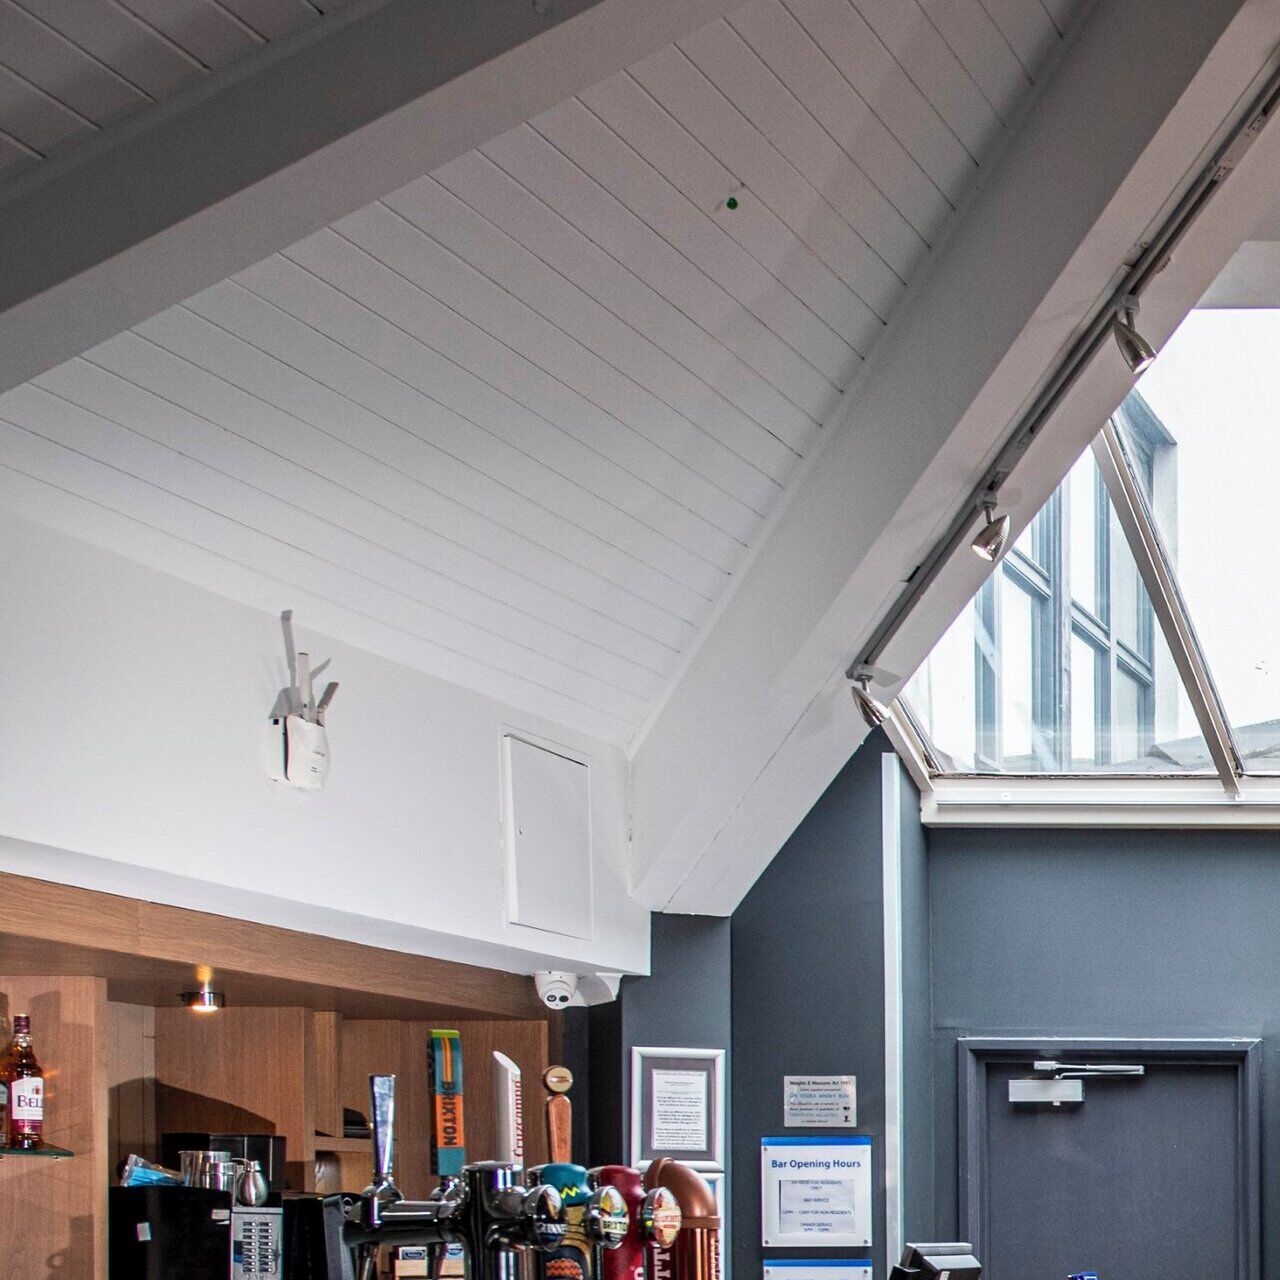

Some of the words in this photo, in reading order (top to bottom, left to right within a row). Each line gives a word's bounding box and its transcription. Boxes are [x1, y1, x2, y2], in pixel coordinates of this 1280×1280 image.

[442, 1081, 458, 1147] BRIXTON
[513, 1080, 523, 1158] Cruzcampo
[790, 1160, 830, 1169] Opening
